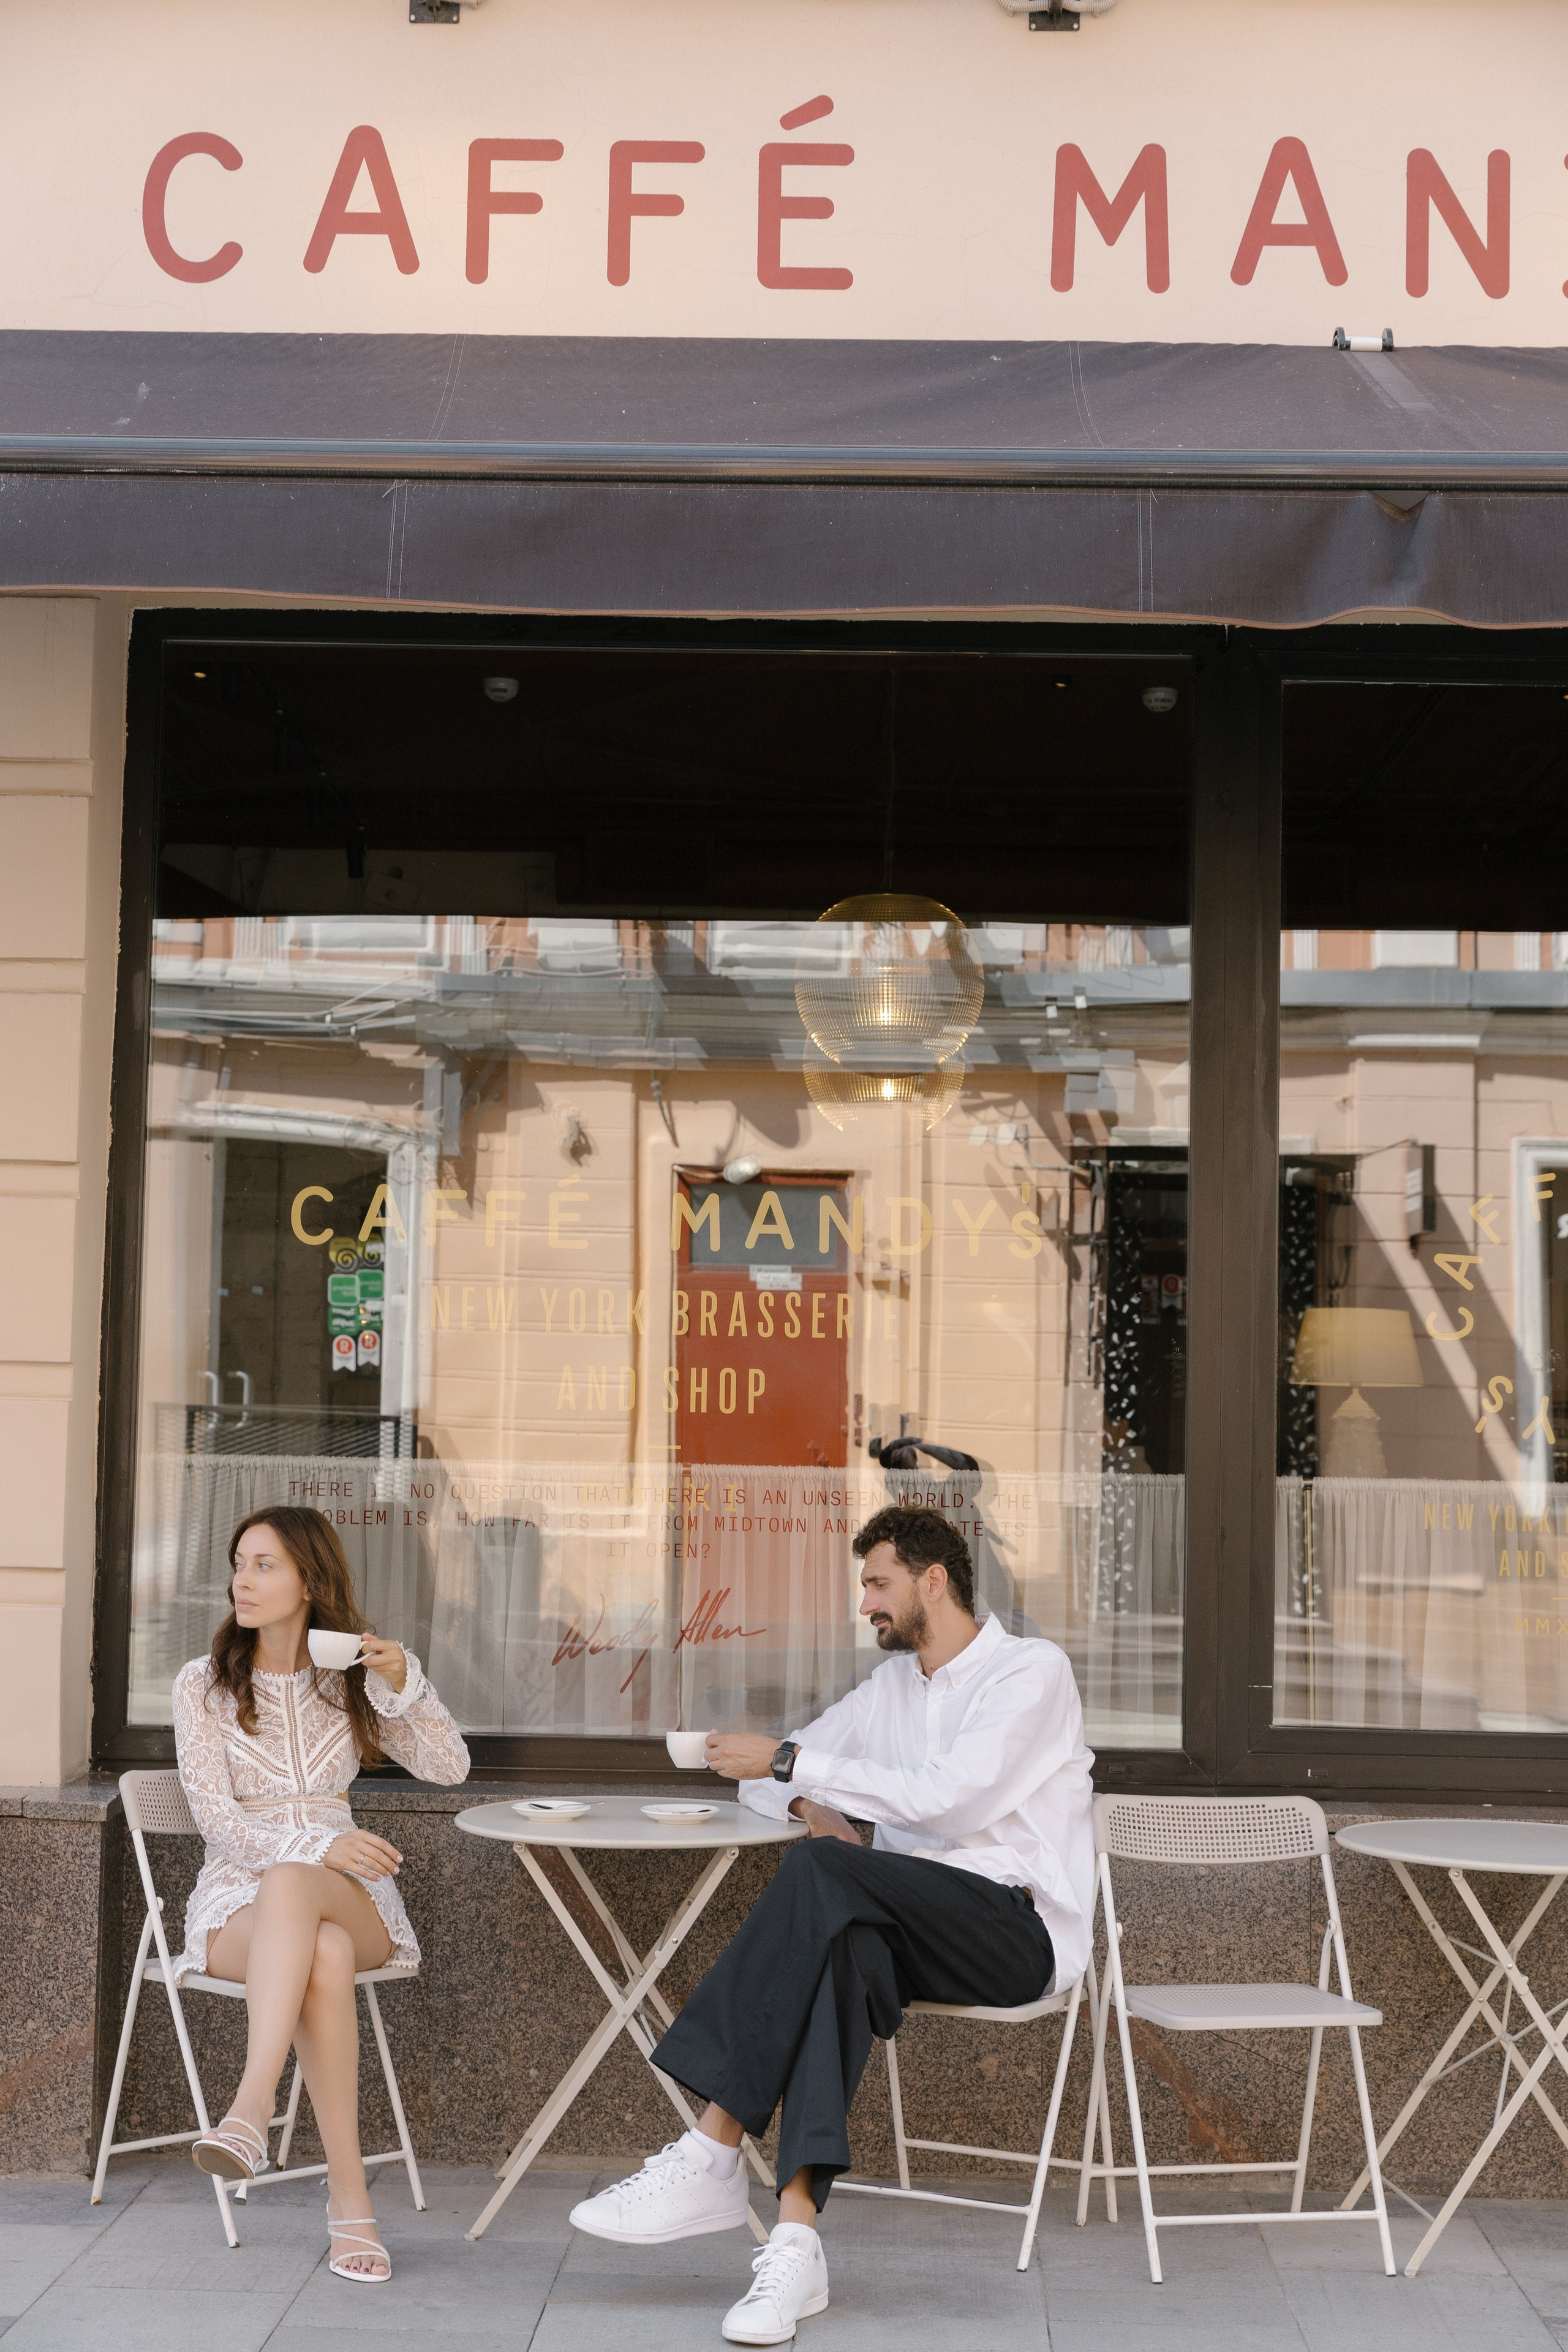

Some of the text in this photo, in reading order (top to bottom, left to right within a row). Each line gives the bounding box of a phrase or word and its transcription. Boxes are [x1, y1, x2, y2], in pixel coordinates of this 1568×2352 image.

[142, 94, 1568, 300] CAFFÉ MAN
[291, 1174, 589, 1250] CAFFÉ
[430, 1286, 898, 1340] NEW YORK BRASSERIE
[556, 1365, 766, 1414] AND SHOP
[288, 1480, 1032, 1510] THERE IS NO QUESTION THAT THERE IS AN UNSEEN WORLD. THE
[323, 1509, 387, 1526] OBLEM
[456, 1510, 495, 1527] HOW
[512, 1512, 549, 1528] FAR
[567, 1513, 590, 1529] IS
[606, 1513, 631, 1529] IT
[647, 1515, 698, 1531] FROM
[714, 1516, 807, 1533] MIDTOWN
[823, 1518, 860, 1534] AND
[1001, 1521, 1025, 1537] IS
[1423, 1502, 1474, 1531] NEW
[1488, 1504, 1550, 1533] YORK
[606, 1542, 710, 1559] IT OPEN?
[1498, 1549, 1546, 1578] AND
